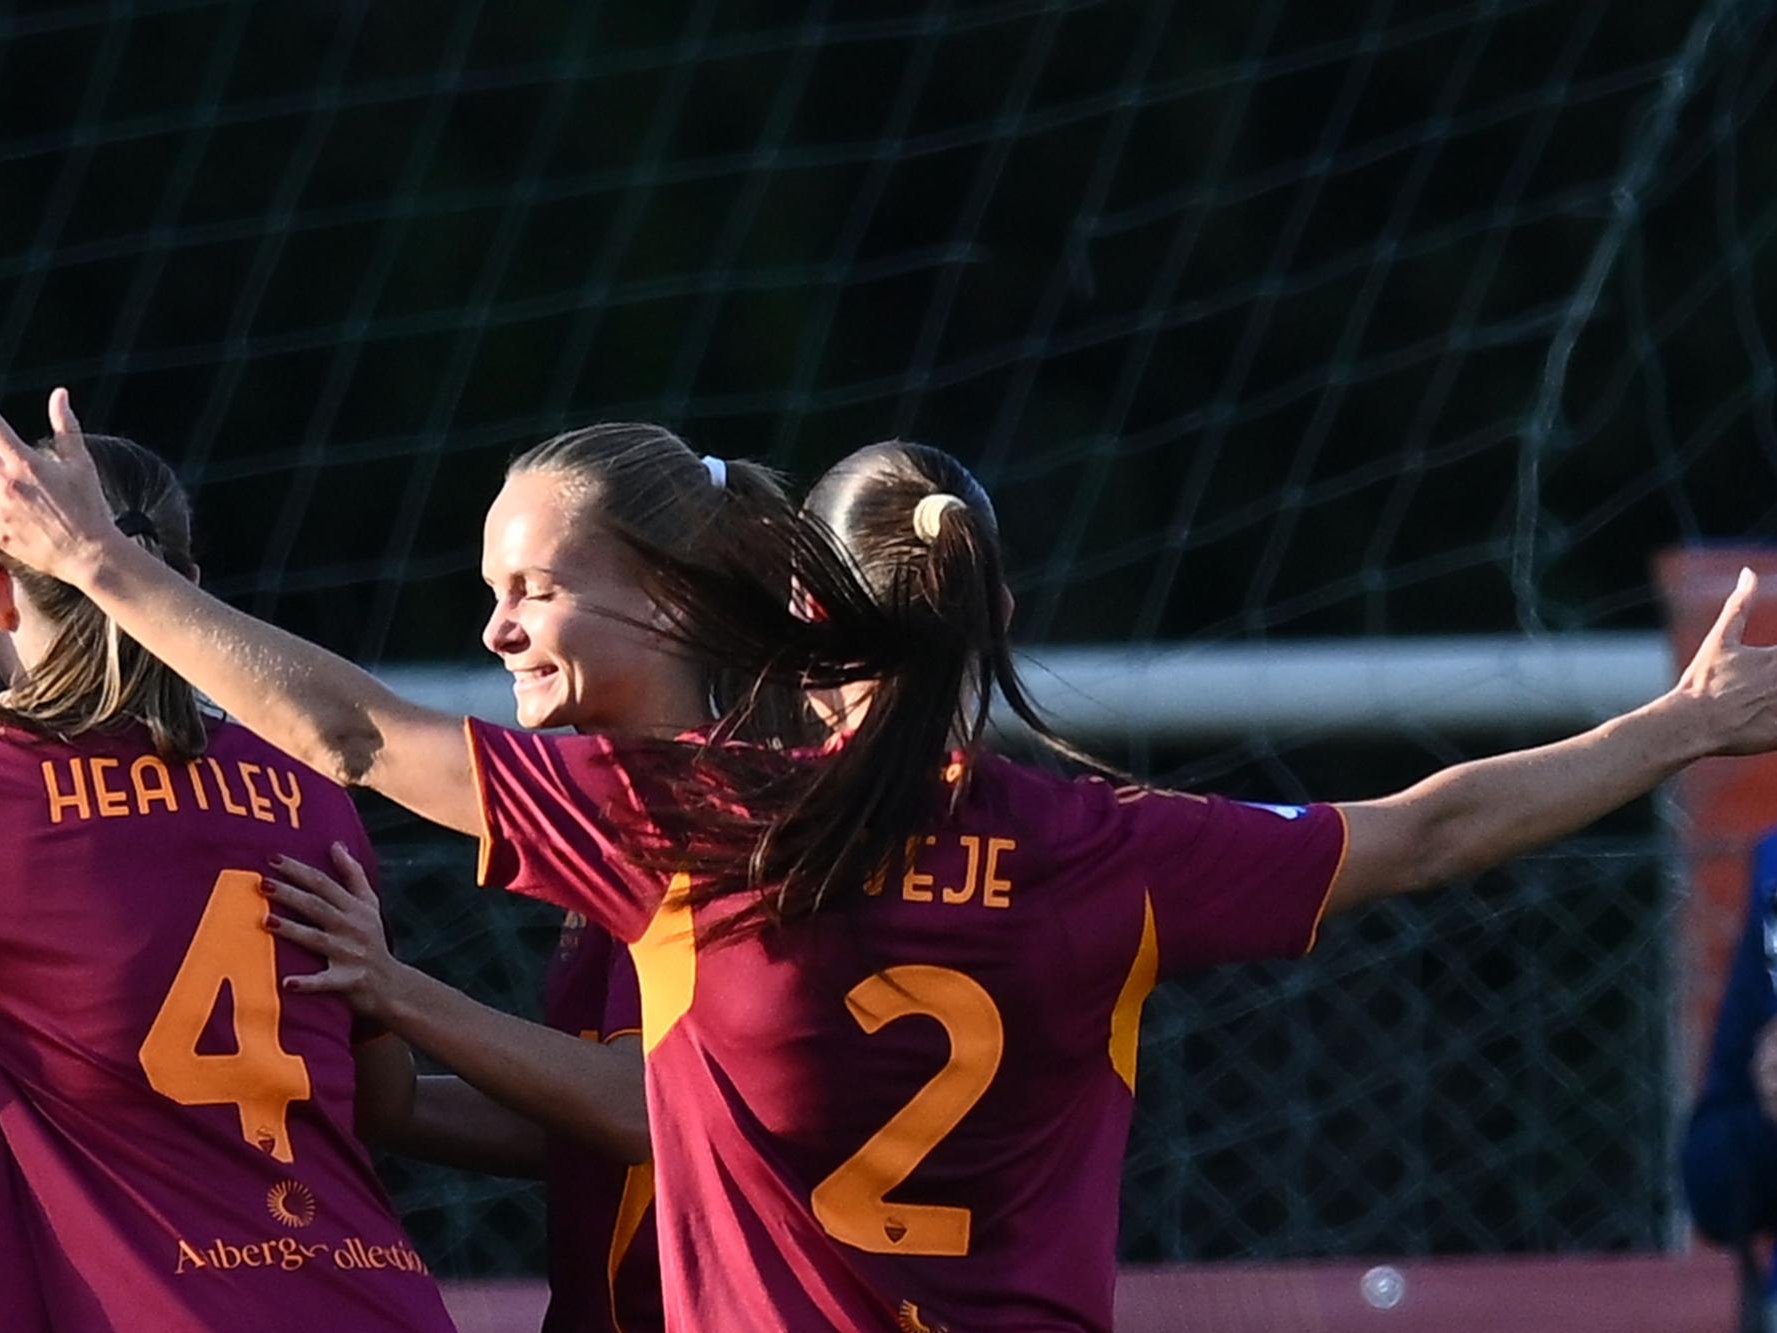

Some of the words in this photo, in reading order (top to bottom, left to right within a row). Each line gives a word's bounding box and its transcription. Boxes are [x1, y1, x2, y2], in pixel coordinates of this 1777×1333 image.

[41, 754, 303, 830] HEATLEY
[137, 868, 311, 1164] 4
[810, 964, 1005, 1257] 2
